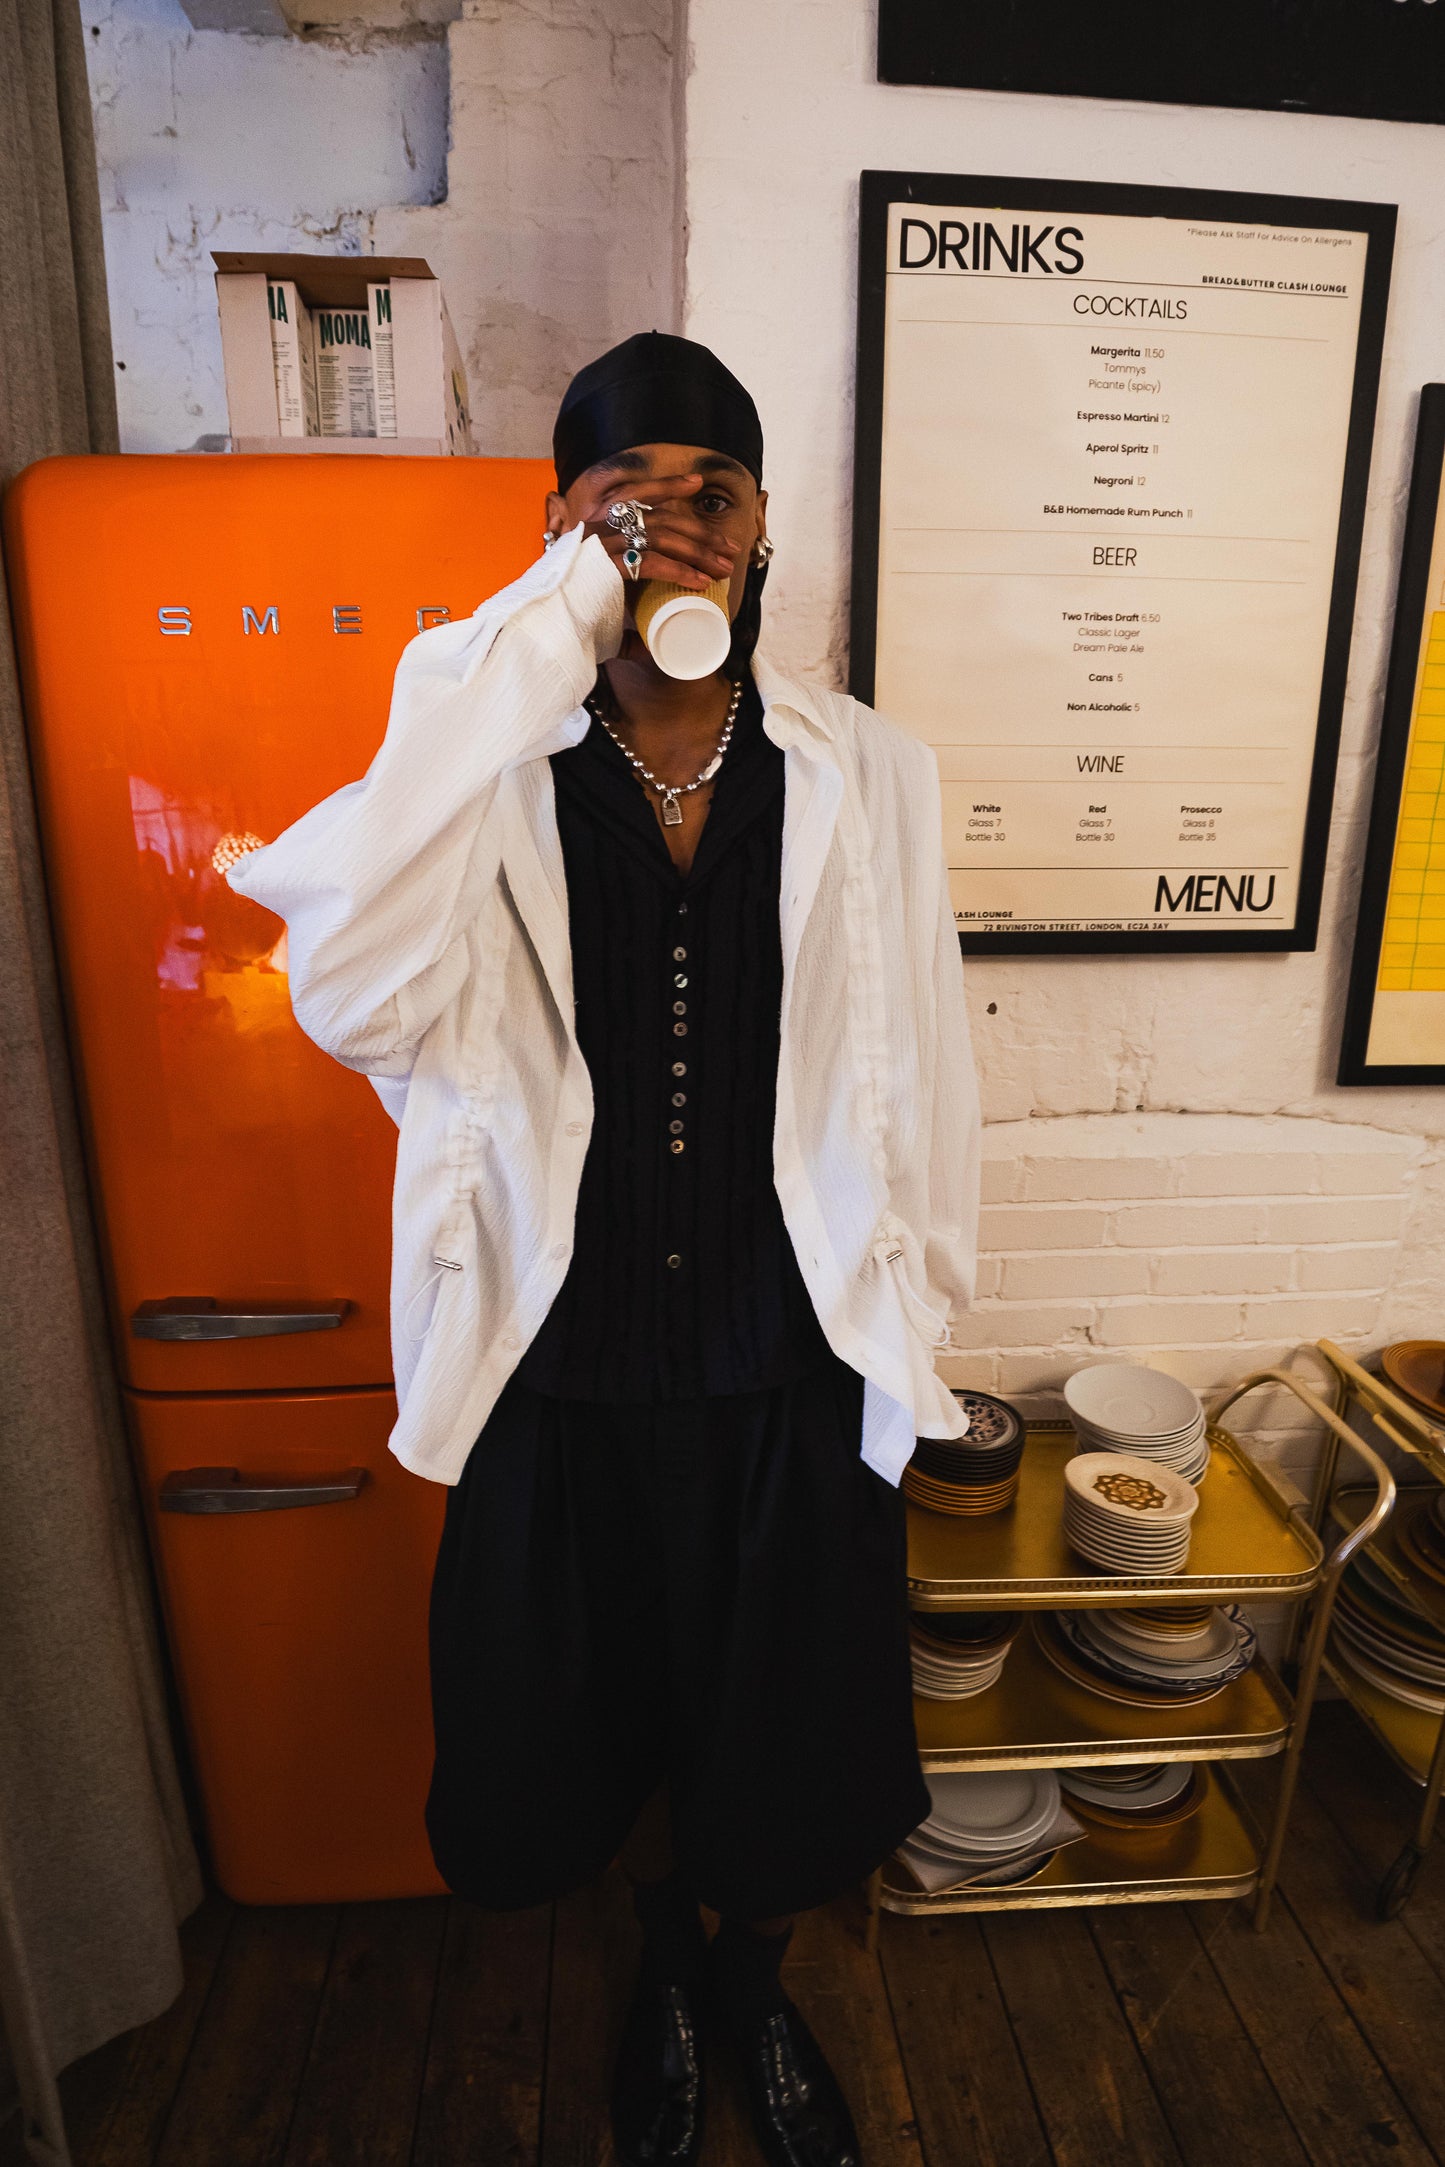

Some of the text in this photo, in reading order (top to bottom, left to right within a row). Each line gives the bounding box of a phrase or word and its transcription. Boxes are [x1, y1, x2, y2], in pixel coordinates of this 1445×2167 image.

[1236, 231, 1255, 239] Staff
[1258, 232, 1269, 240] For
[1314, 238, 1352, 247] Allergens
[899, 218, 1084, 275] DRINKS
[1202, 276, 1347, 293] BREAD&BUTTER CLASH LOUNGE
[1073, 294, 1188, 320] COCKTAILS
[319, 313, 371, 349] MOMA
[1090, 345, 1141, 359] Margerita
[1104, 362, 1147, 376] Tommys
[1088, 378, 1162, 394] Picante (spicy)
[1076, 410, 1170, 423] Espresso Martini 12
[1085, 443, 1119, 455] Aperol
[1121, 443, 1149, 456] Spritz
[1093, 475, 1146, 488] Negroni 12
[1043, 504, 1065, 514] B&B
[1065, 505, 1126, 516] Homemade
[1127, 507, 1150, 517] Rum
[1152, 508, 1183, 518] Punch
[1092, 547, 1137, 567] BEER
[157, 605, 451, 636] SMEG
[1061, 611, 1161, 623] Two Tribes Draft 6.50
[1077, 627, 1141, 641] Classic Lager
[1072, 642, 1145, 654] Dream Pale Ale
[1088, 673, 1123, 683] Cans 5
[1066, 702, 1140, 713] Non Alcoholic 5
[1076, 755, 1125, 773] WINE
[972, 804, 1001, 813] White
[1088, 804, 1106, 814] Red
[1180, 805, 1223, 814] Prosecco
[967, 818, 1002, 828] Glass 7
[1078, 818, 1112, 828] Glass 7
[1182, 819, 1215, 828] Glass 8
[965, 832, 1006, 842] Bottle 30
[1075, 832, 1115, 842] Bottle 30
[1178, 832, 1217, 842] Bottle 35
[1154, 874, 1275, 913] MENU
[954, 911, 1013, 919] LASH LOUNGE
[996, 923, 1046, 931] RIVINGTON
[1127, 922, 1150, 930] EC2A
[1152, 922, 1169, 930] 3AY
